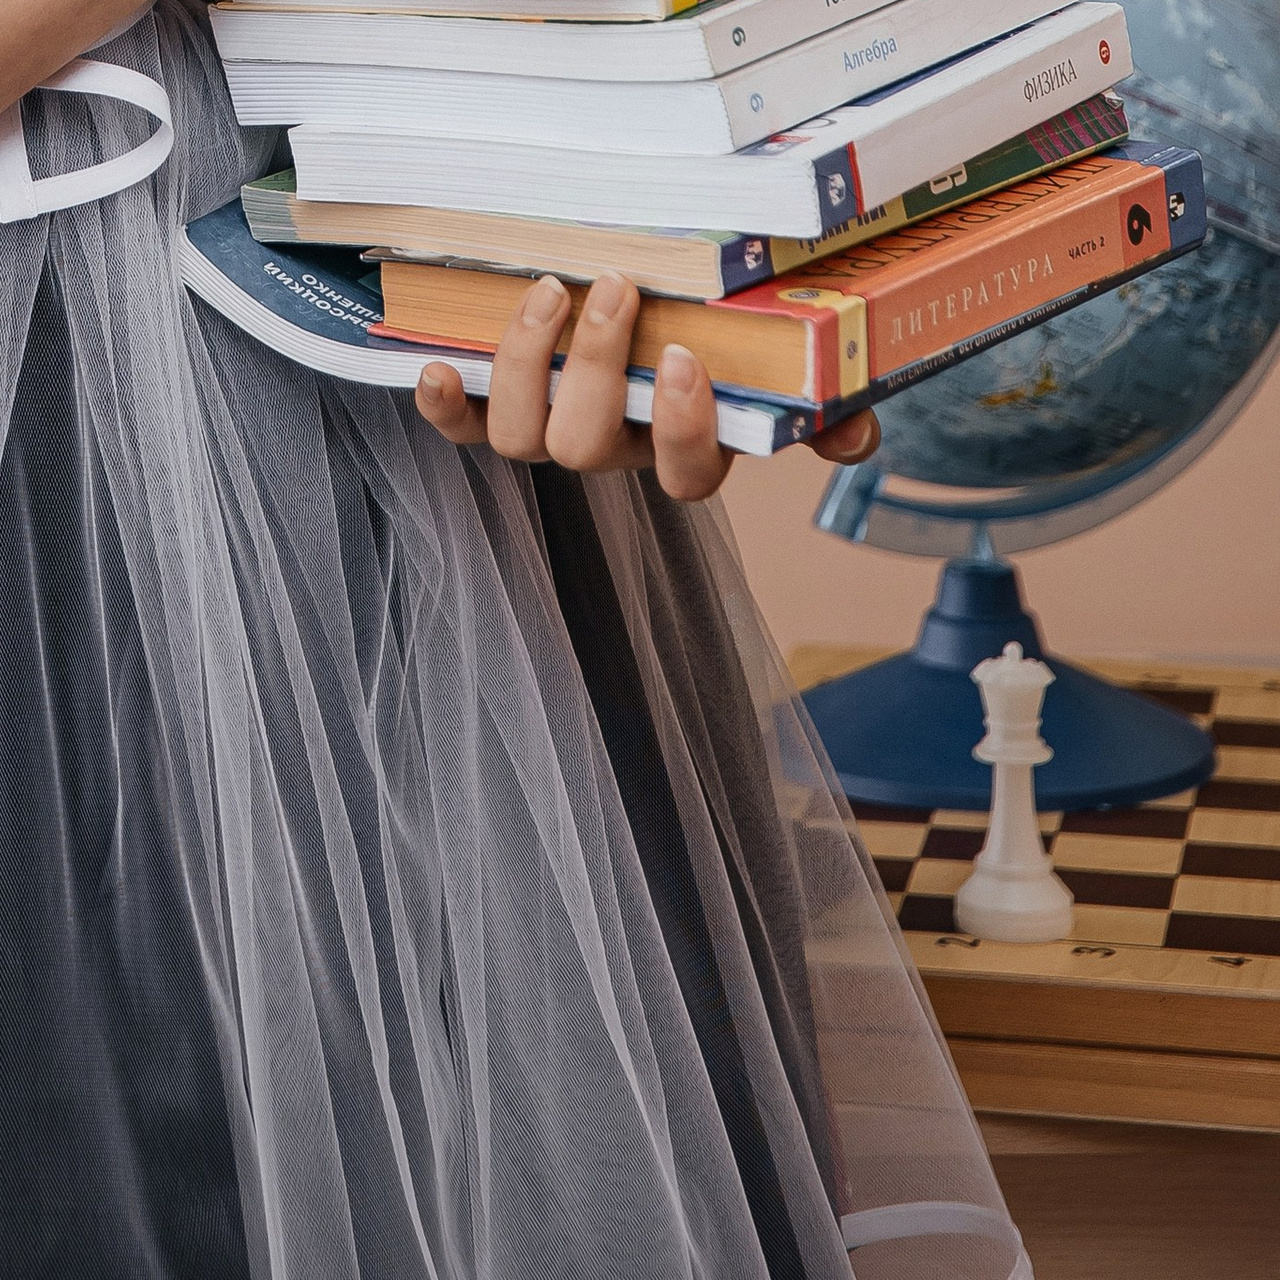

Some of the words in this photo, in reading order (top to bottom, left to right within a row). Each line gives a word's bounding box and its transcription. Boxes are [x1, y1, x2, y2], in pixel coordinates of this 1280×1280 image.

[843, 37, 898, 72] Алгебра
[1023, 58, 1078, 103] ФИЗИКА
[1068, 238, 1098, 261] ЧАСТЬ
[1099, 235, 1107, 248] 2
[263, 261, 375, 330] ВЫСОЦКИЙ
[889, 252, 1055, 345] ЛИТЕРАТУРА
